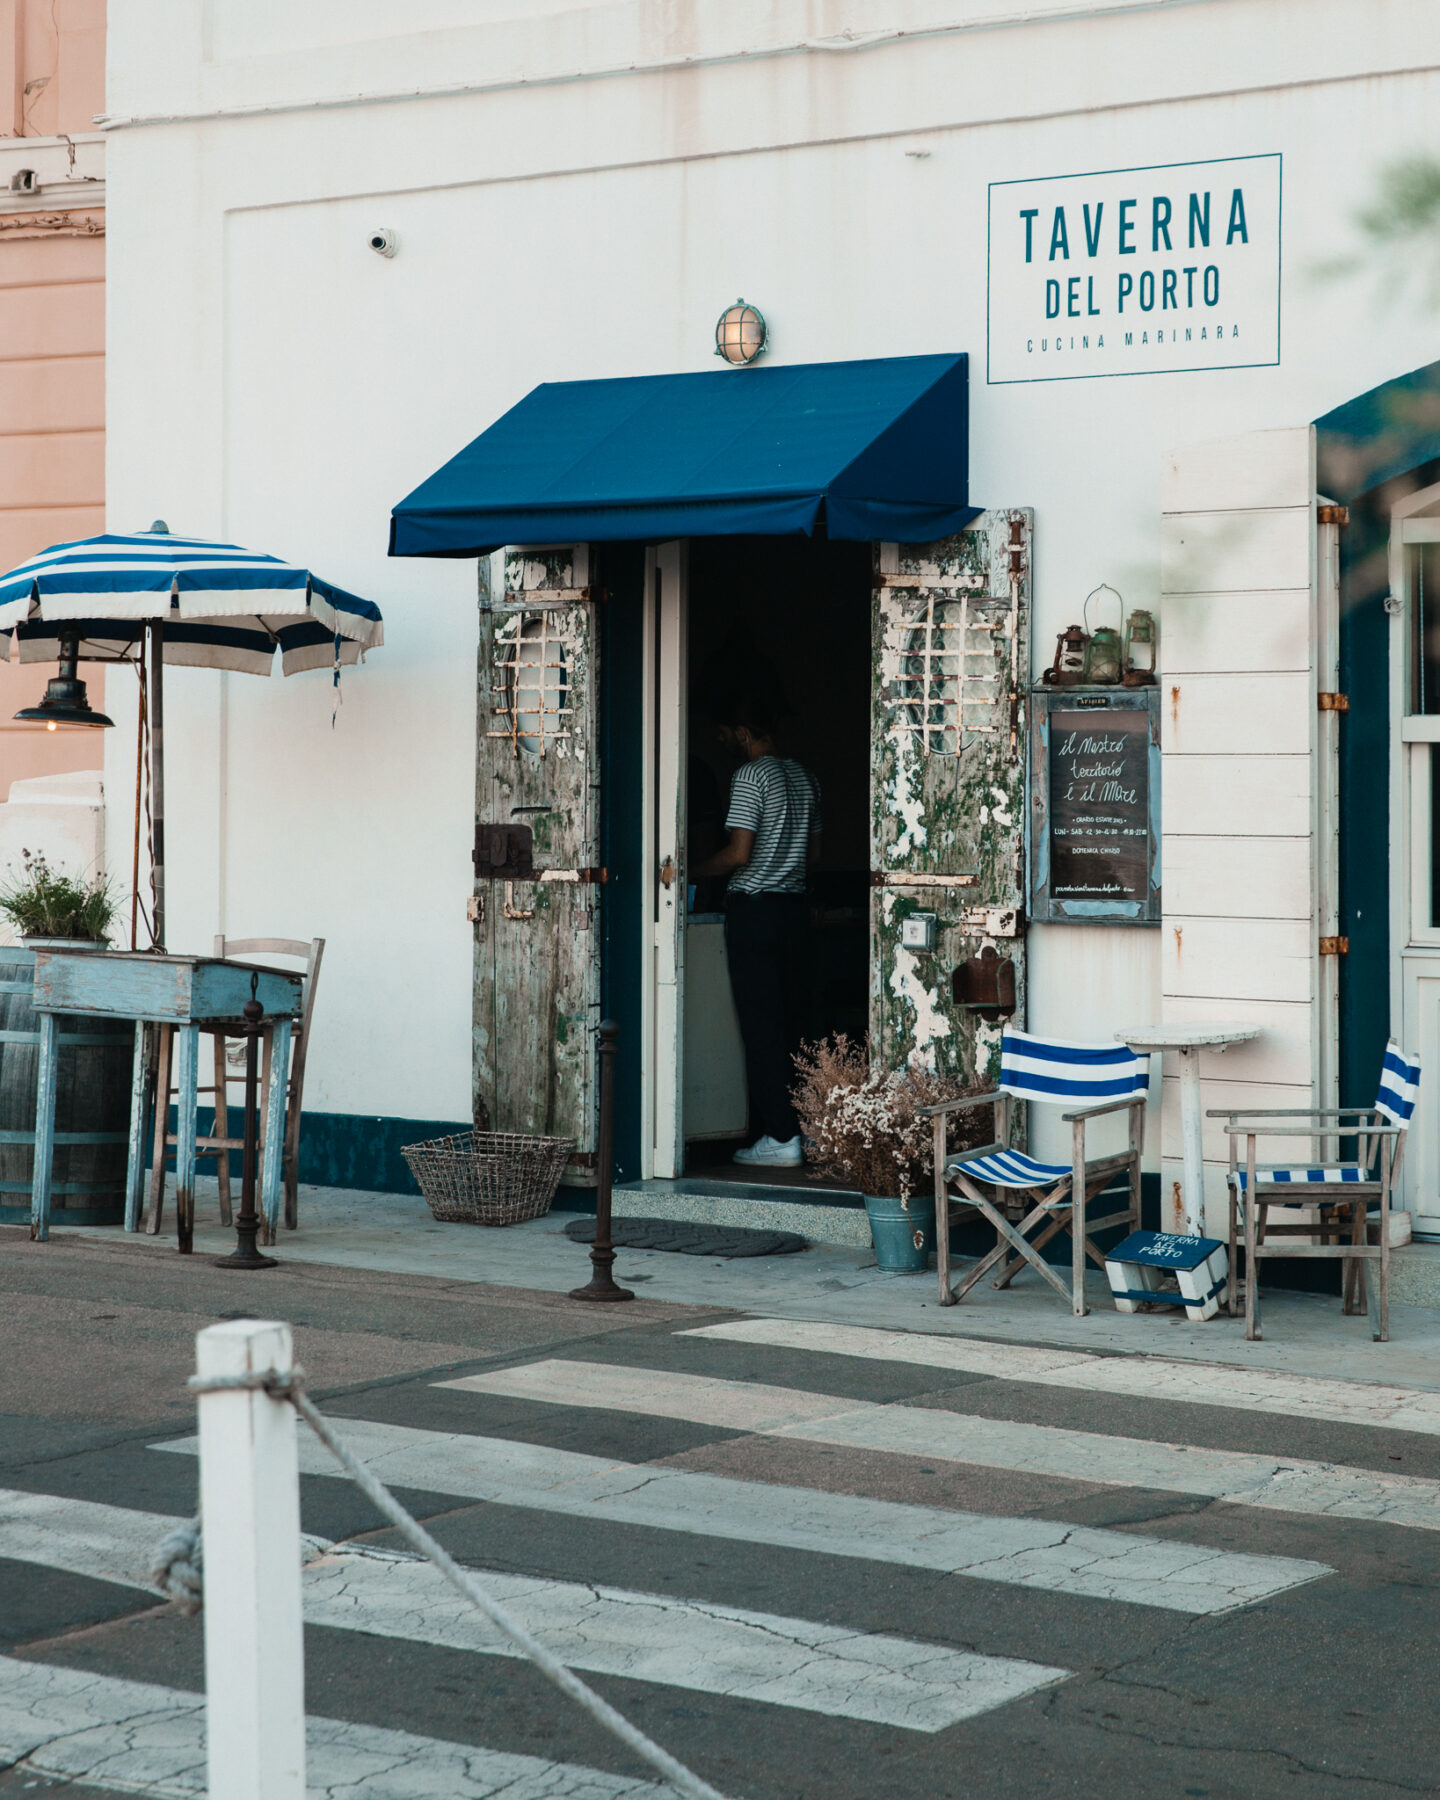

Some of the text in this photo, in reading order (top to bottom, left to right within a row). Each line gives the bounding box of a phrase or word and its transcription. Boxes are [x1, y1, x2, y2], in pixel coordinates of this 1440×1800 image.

[1019, 188, 1249, 264] TAVERNA
[1045, 264, 1220, 320] DEL PORTO
[1027, 324, 1239, 353] CUCINA MARINARA
[1153, 1233, 1199, 1246] TAVERNA
[1153, 1241, 1175, 1250] DEL
[1138, 1246, 1183, 1258] PORTO
